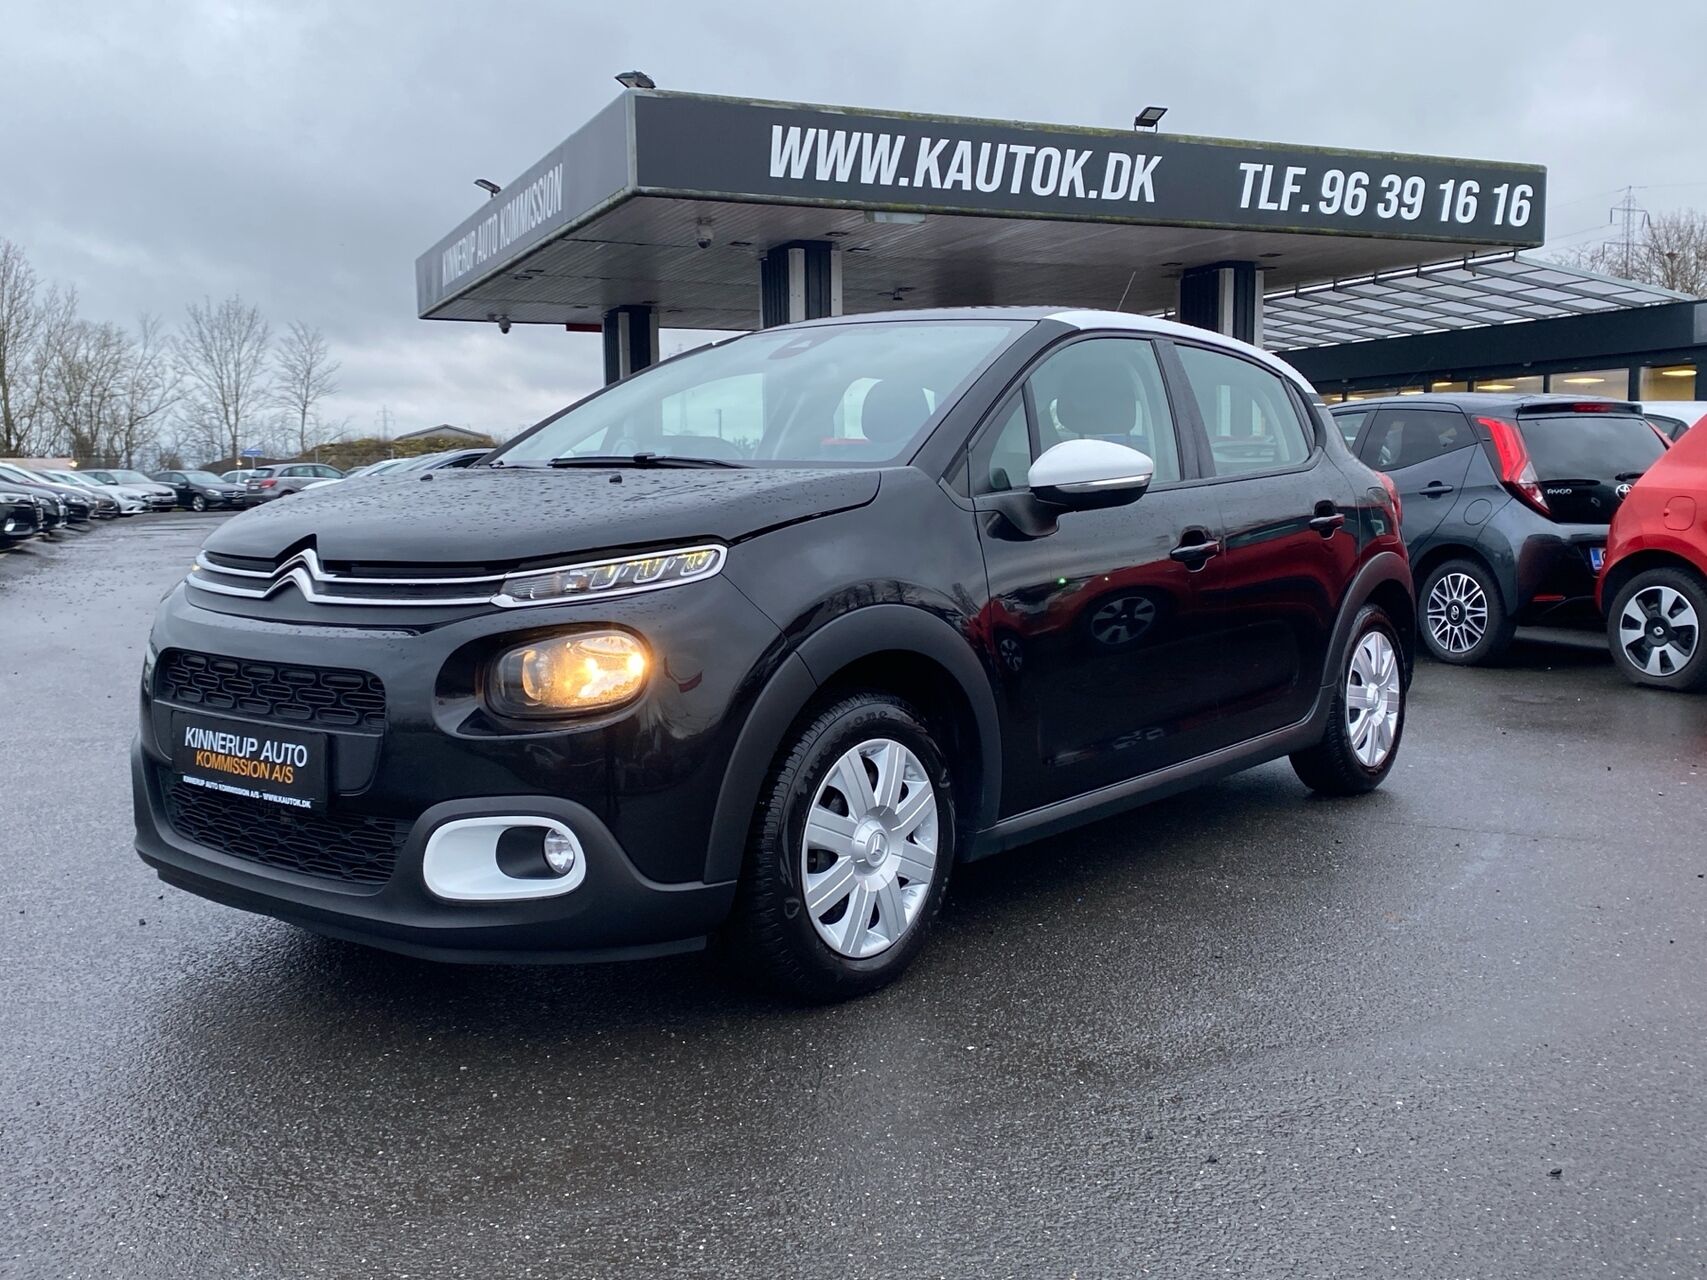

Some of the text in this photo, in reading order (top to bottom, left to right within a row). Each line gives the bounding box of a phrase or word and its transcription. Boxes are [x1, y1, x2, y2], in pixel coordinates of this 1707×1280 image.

[769, 125, 1162, 203] WWW.KAUTOK.DK
[1239, 162, 1534, 227] TLF. 96 39 16 16
[477, 213, 498, 264] AUTO
[500, 163, 563, 250] KOMMISSION
[184, 726, 308, 768] KINNERUP AUTO
[195, 750, 294, 784] KOMMISSION A/S
